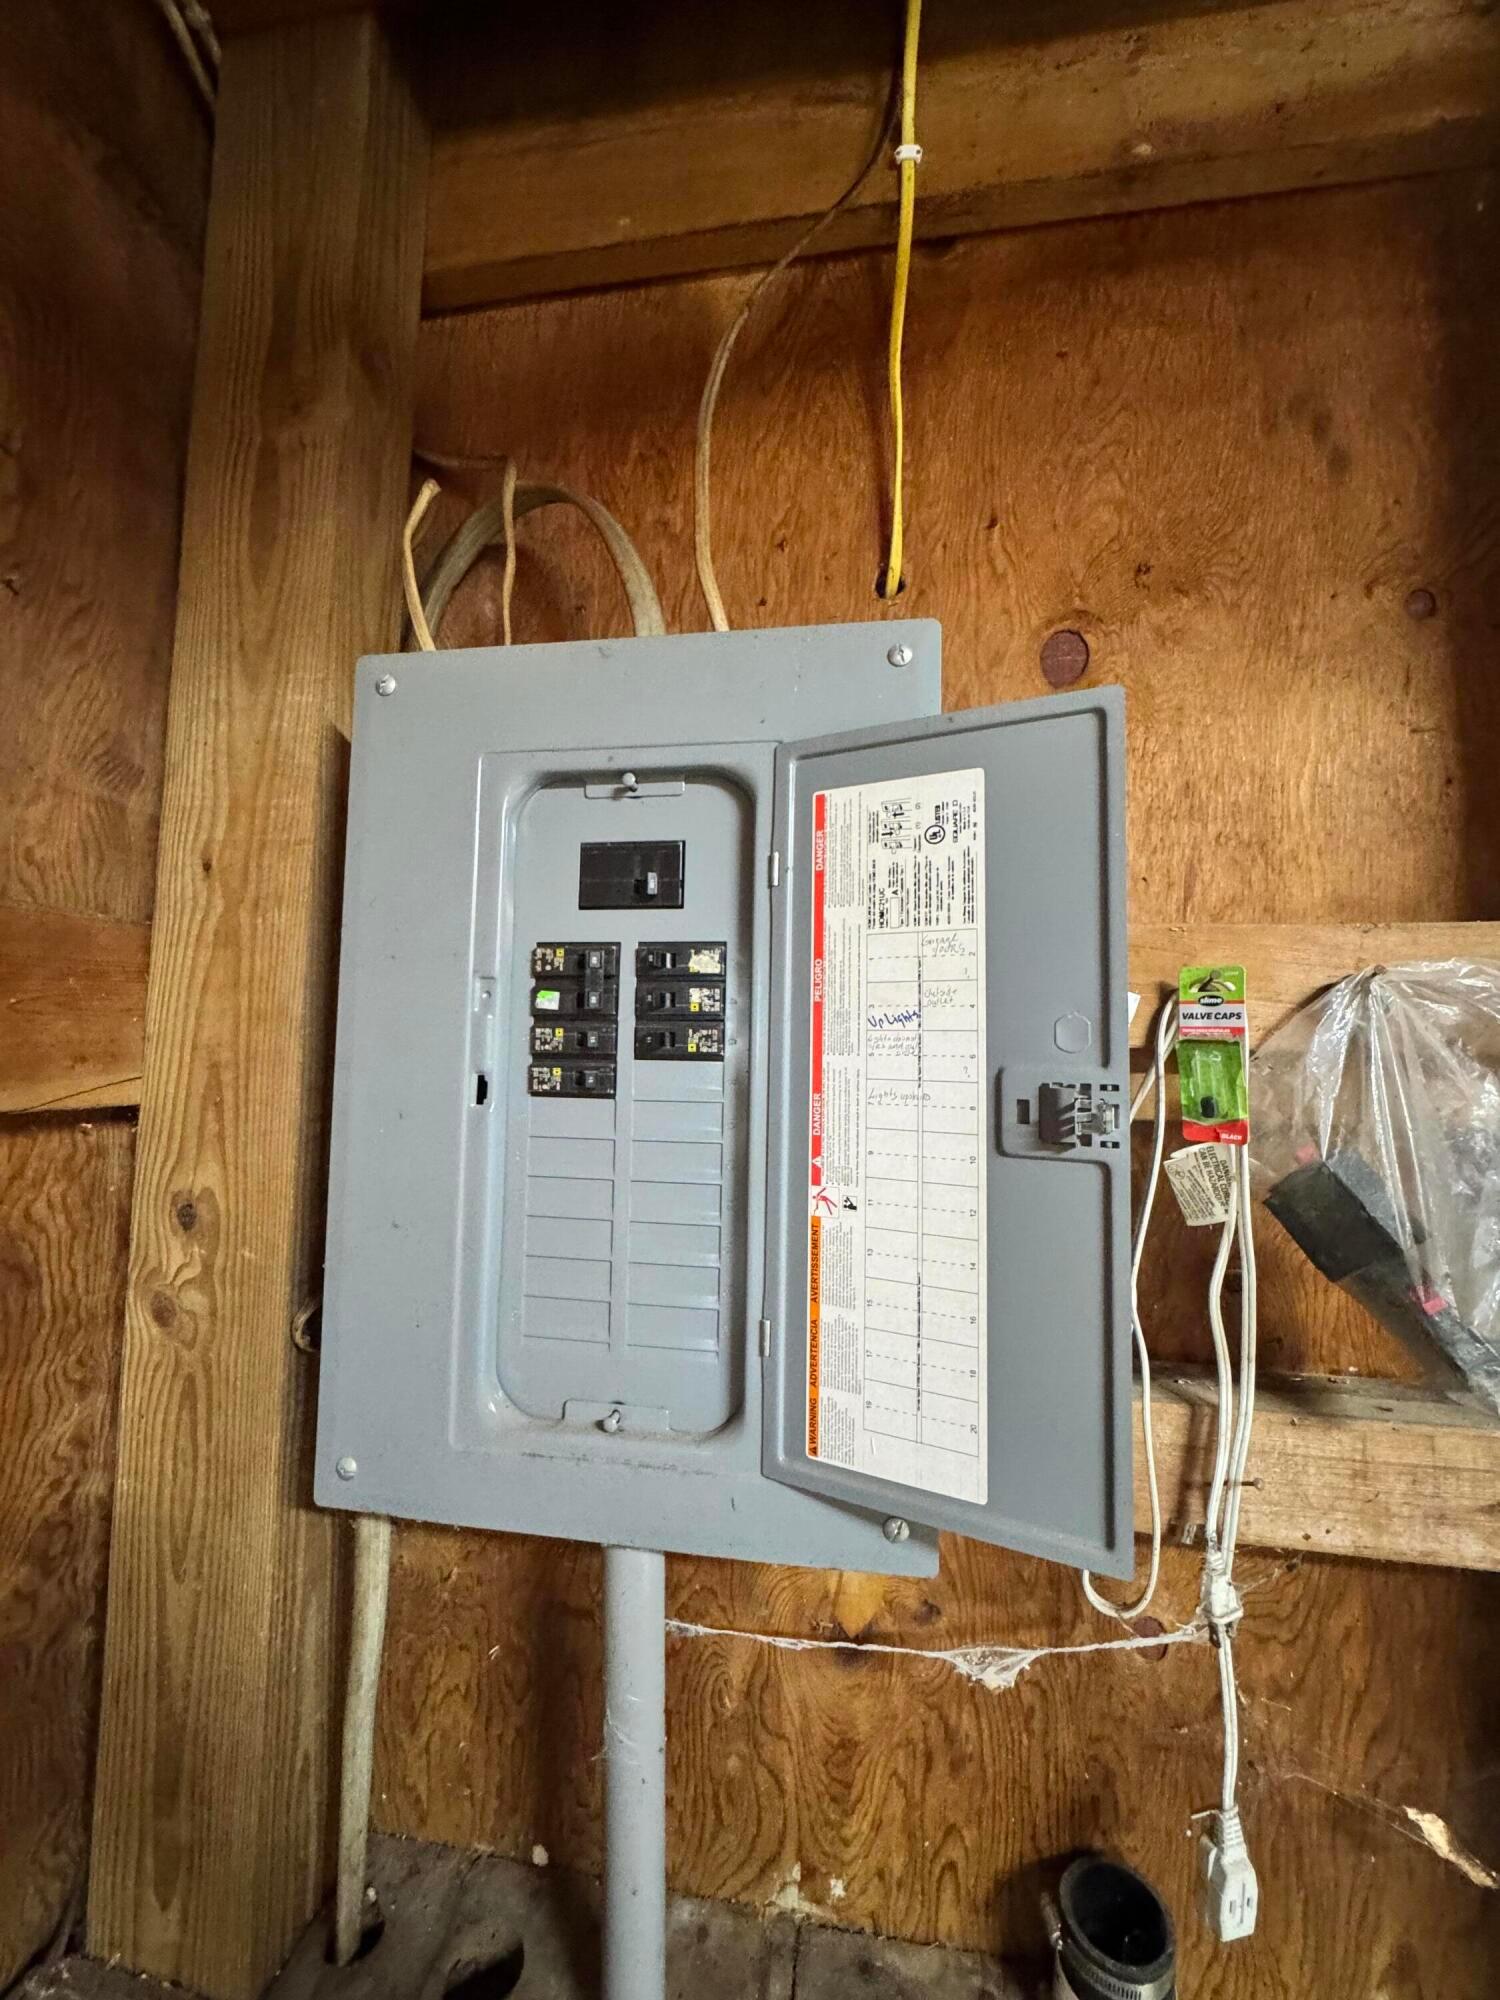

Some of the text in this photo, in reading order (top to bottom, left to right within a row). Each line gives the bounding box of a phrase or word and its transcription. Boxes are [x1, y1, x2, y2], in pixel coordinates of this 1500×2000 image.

[815, 830, 825, 871] DANGER
[814, 958, 823, 1002] PELIGRO
[868, 1010, 920, 1029] Up Lights
[1182, 1012, 1242, 1020] VALVE CAPS
[813, 1092, 822, 1136] DANGER
[969, 1156, 976, 1164] 10
[1202, 1158, 1211, 1169] BE
[1206, 1145, 1224, 1182] ELECTRICAL
[969, 1209, 976, 1217] 12
[867, 1248, 874, 1257] 13
[810, 1223, 819, 1303] AVERTISSEMENT
[969, 1262, 976, 1271] 14
[866, 1299, 873, 1307] 15
[969, 1316, 977, 1325] 16
[810, 1319, 818, 1387] ADVERTENCIA
[866, 1349, 873, 1358] 17
[969, 1369, 977, 1378] 18
[865, 1400, 872, 1409] 19
[809, 1398, 817, 1445] WARNING
[970, 1424, 977, 1434] 20
